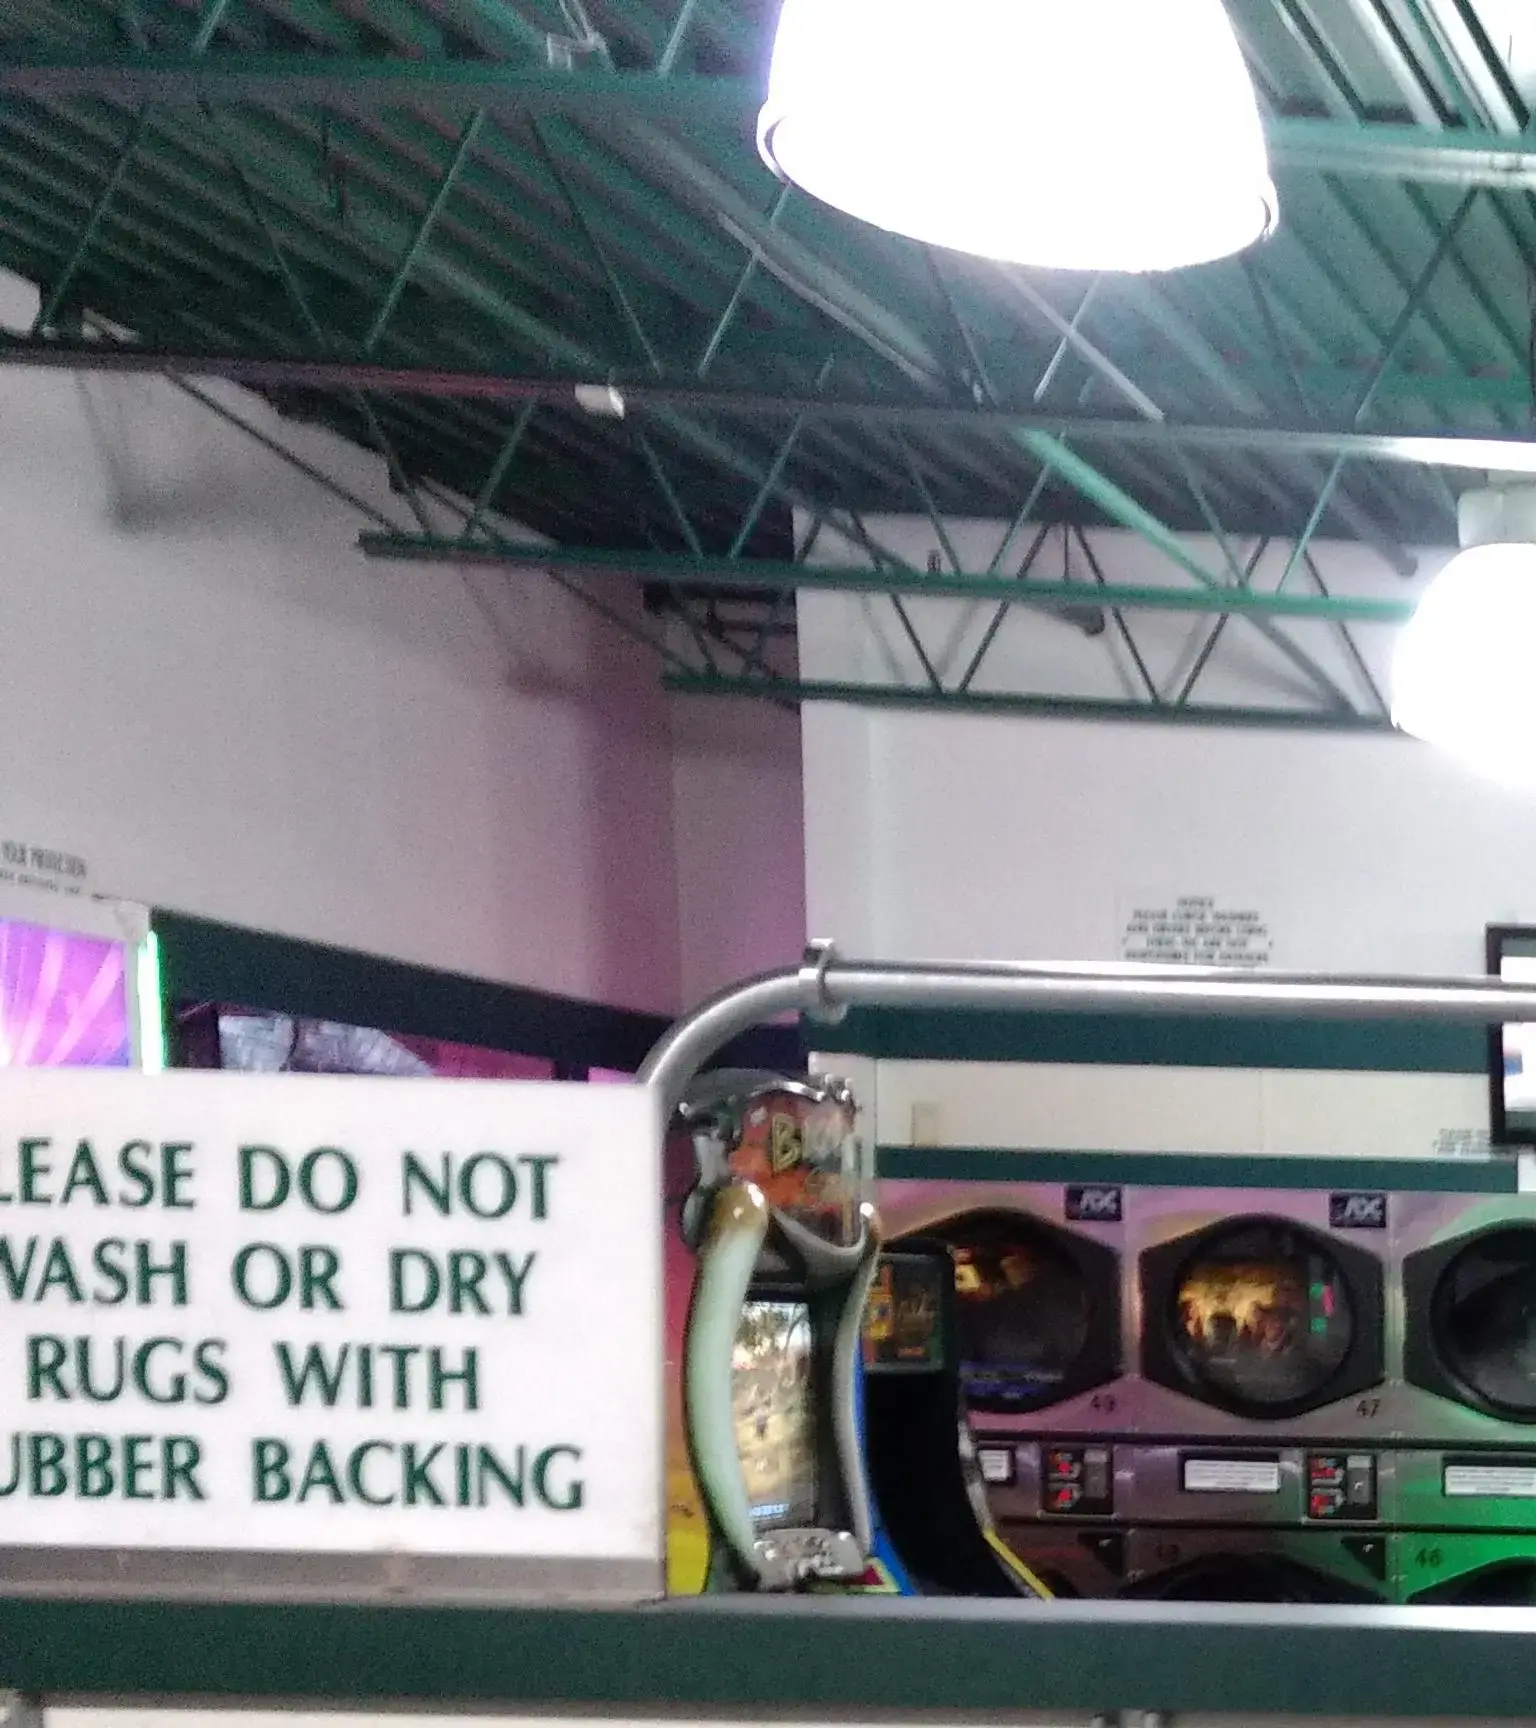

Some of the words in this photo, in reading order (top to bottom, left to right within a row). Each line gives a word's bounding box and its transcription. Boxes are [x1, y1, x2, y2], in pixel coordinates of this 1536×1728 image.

[0, 1136, 196, 1209] EASE
[237, 1143, 360, 1215] DO
[401, 1150, 561, 1222] NOT
[231, 1240, 345, 1311] OR
[387, 1246, 538, 1318] DRY
[25, 1332, 229, 1406] RUGS
[273, 1339, 481, 1412] WITH
[1356, 1398, 1381, 1418] 47
[251, 1437, 586, 1512] BACKING
